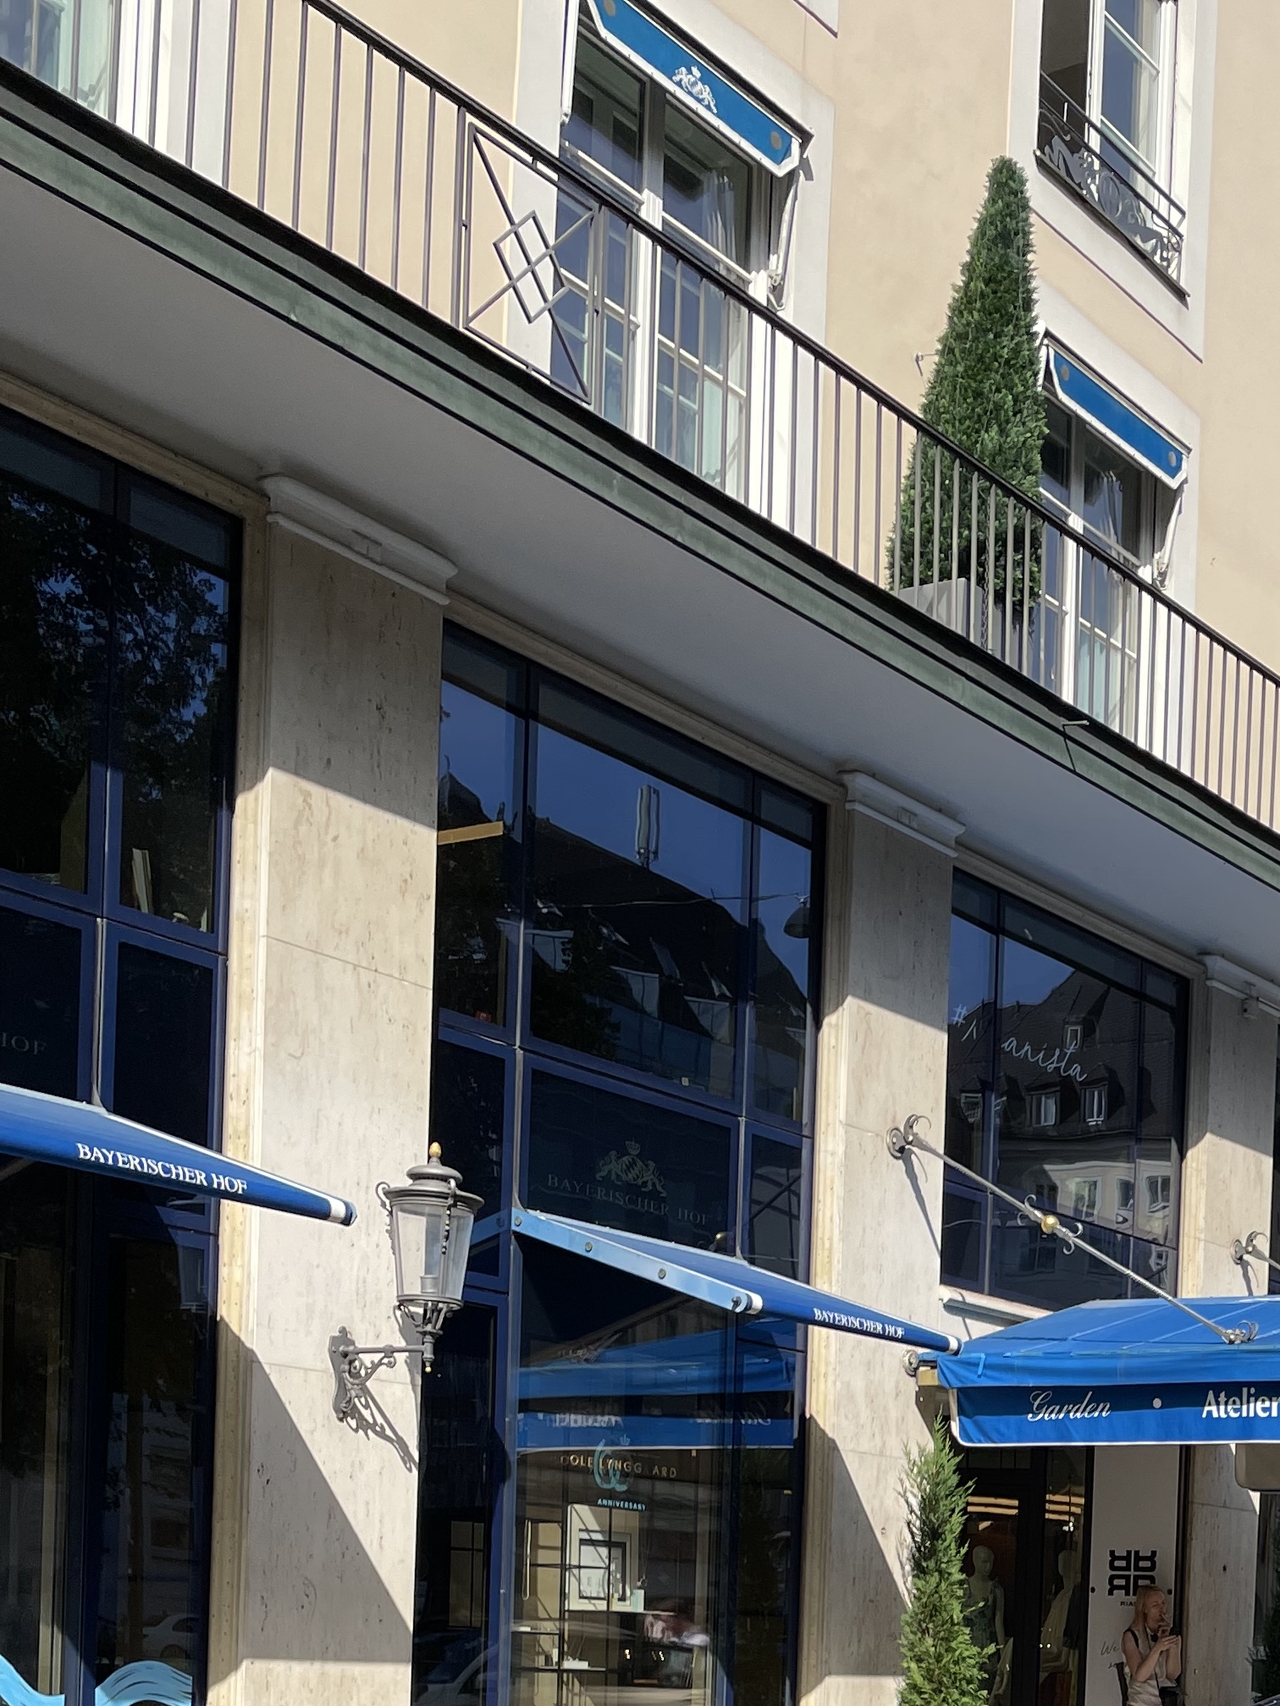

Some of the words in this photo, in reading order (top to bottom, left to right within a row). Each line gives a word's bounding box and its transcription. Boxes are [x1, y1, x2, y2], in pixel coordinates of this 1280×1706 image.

[76, 1142, 207, 1187] BAYERISCHER
[211, 1172, 248, 1195] HOF
[547, 1173, 669, 1216] BAYERISCHER
[678, 1207, 709, 1225] HOF
[813, 1307, 884, 1336] BAYERISCHER
[885, 1323, 906, 1340] HOF
[1027, 1391, 1111, 1421] Garden
[597, 1498, 646, 1511] ANNIVERSARY
